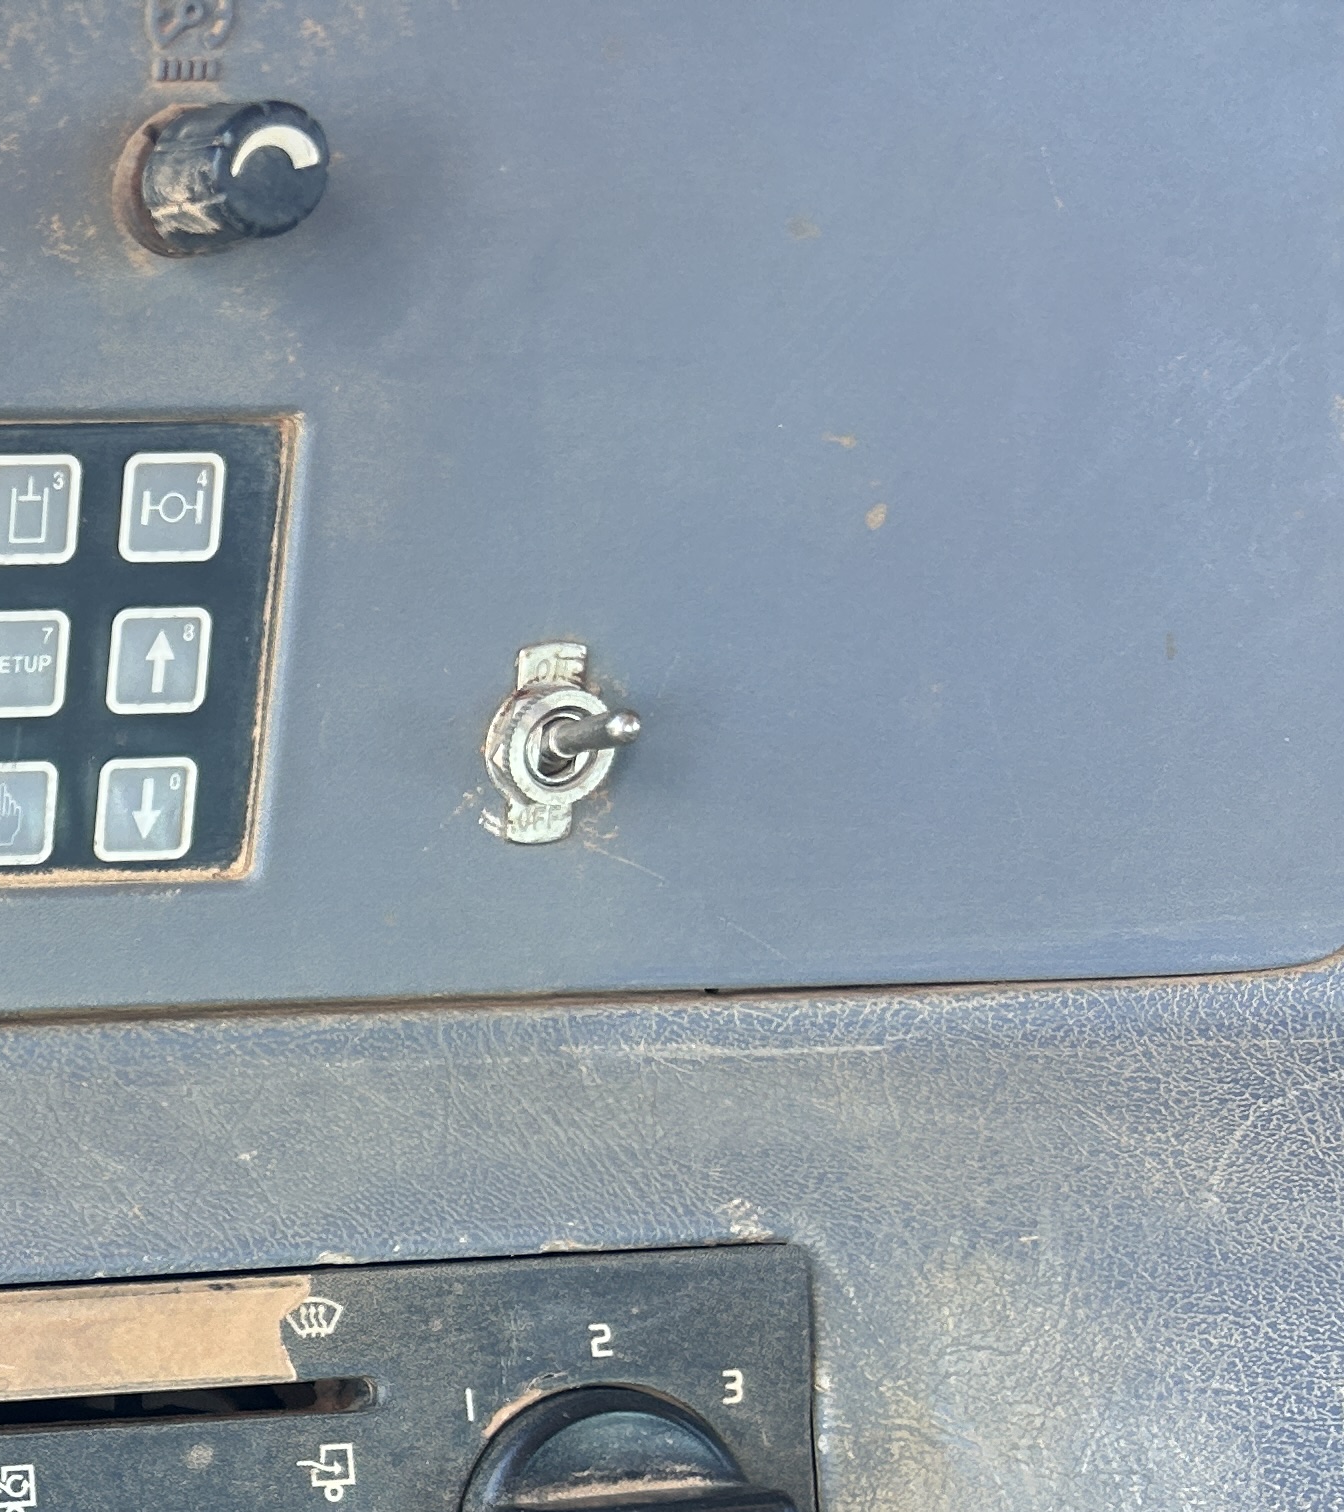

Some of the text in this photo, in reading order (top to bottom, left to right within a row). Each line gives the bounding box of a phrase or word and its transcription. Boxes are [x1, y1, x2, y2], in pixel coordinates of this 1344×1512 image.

[53, 471, 65, 489] 3
[196, 469, 209, 487] 4
[42, 627, 54, 644] 7
[183, 623, 195, 642] 8
[169, 773, 182, 791] 0
[588, 1323, 614, 1357] 2
[722, 1370, 746, 1404] 3
